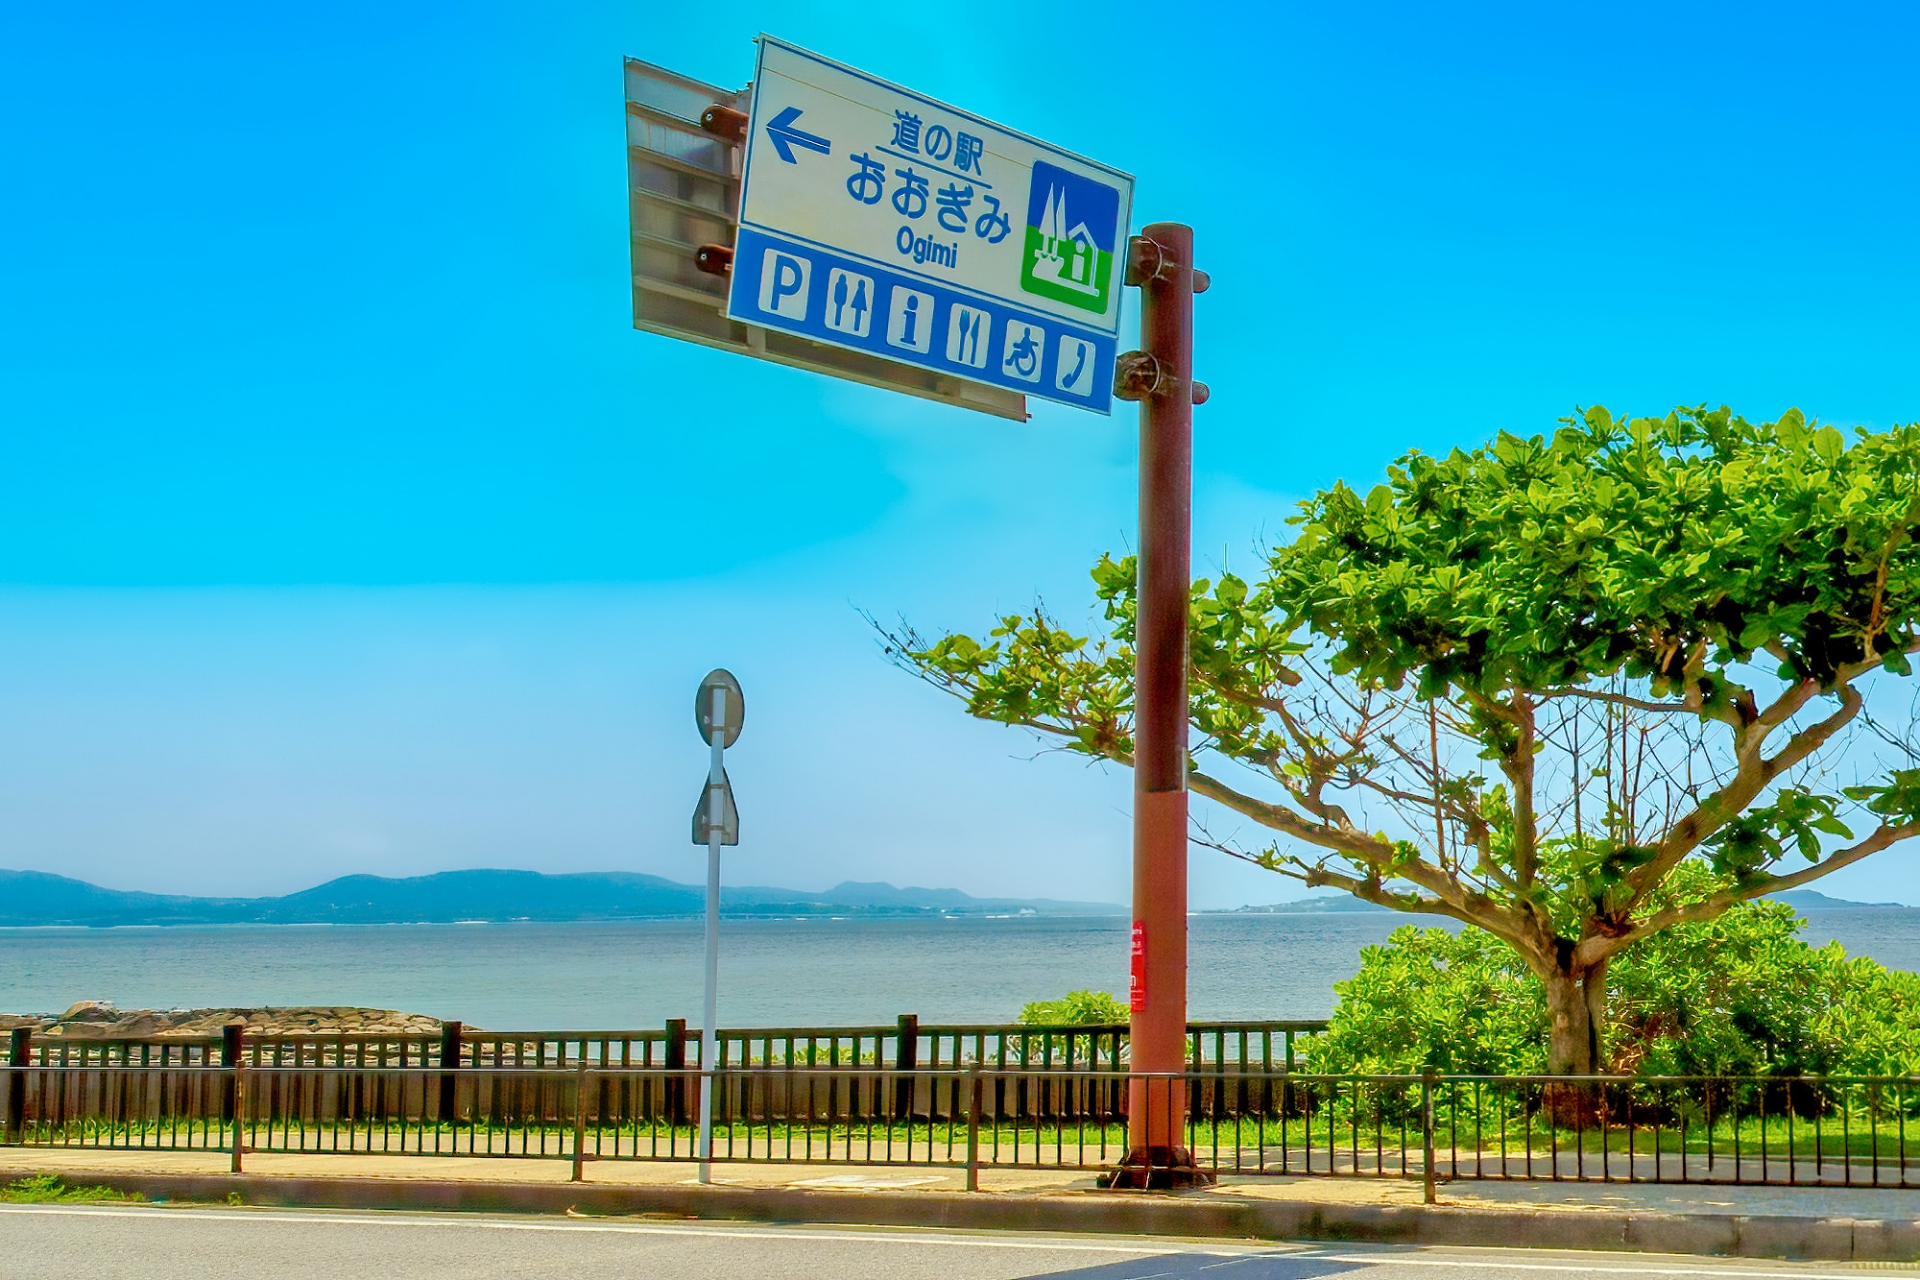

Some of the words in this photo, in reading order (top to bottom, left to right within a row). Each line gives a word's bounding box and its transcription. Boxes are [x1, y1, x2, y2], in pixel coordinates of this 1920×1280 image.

[890, 109, 984, 176] 道の駅
[846, 152, 1011, 244] おおぎみ
[896, 225, 958, 269] Ogimi
[770, 255, 804, 311] P
